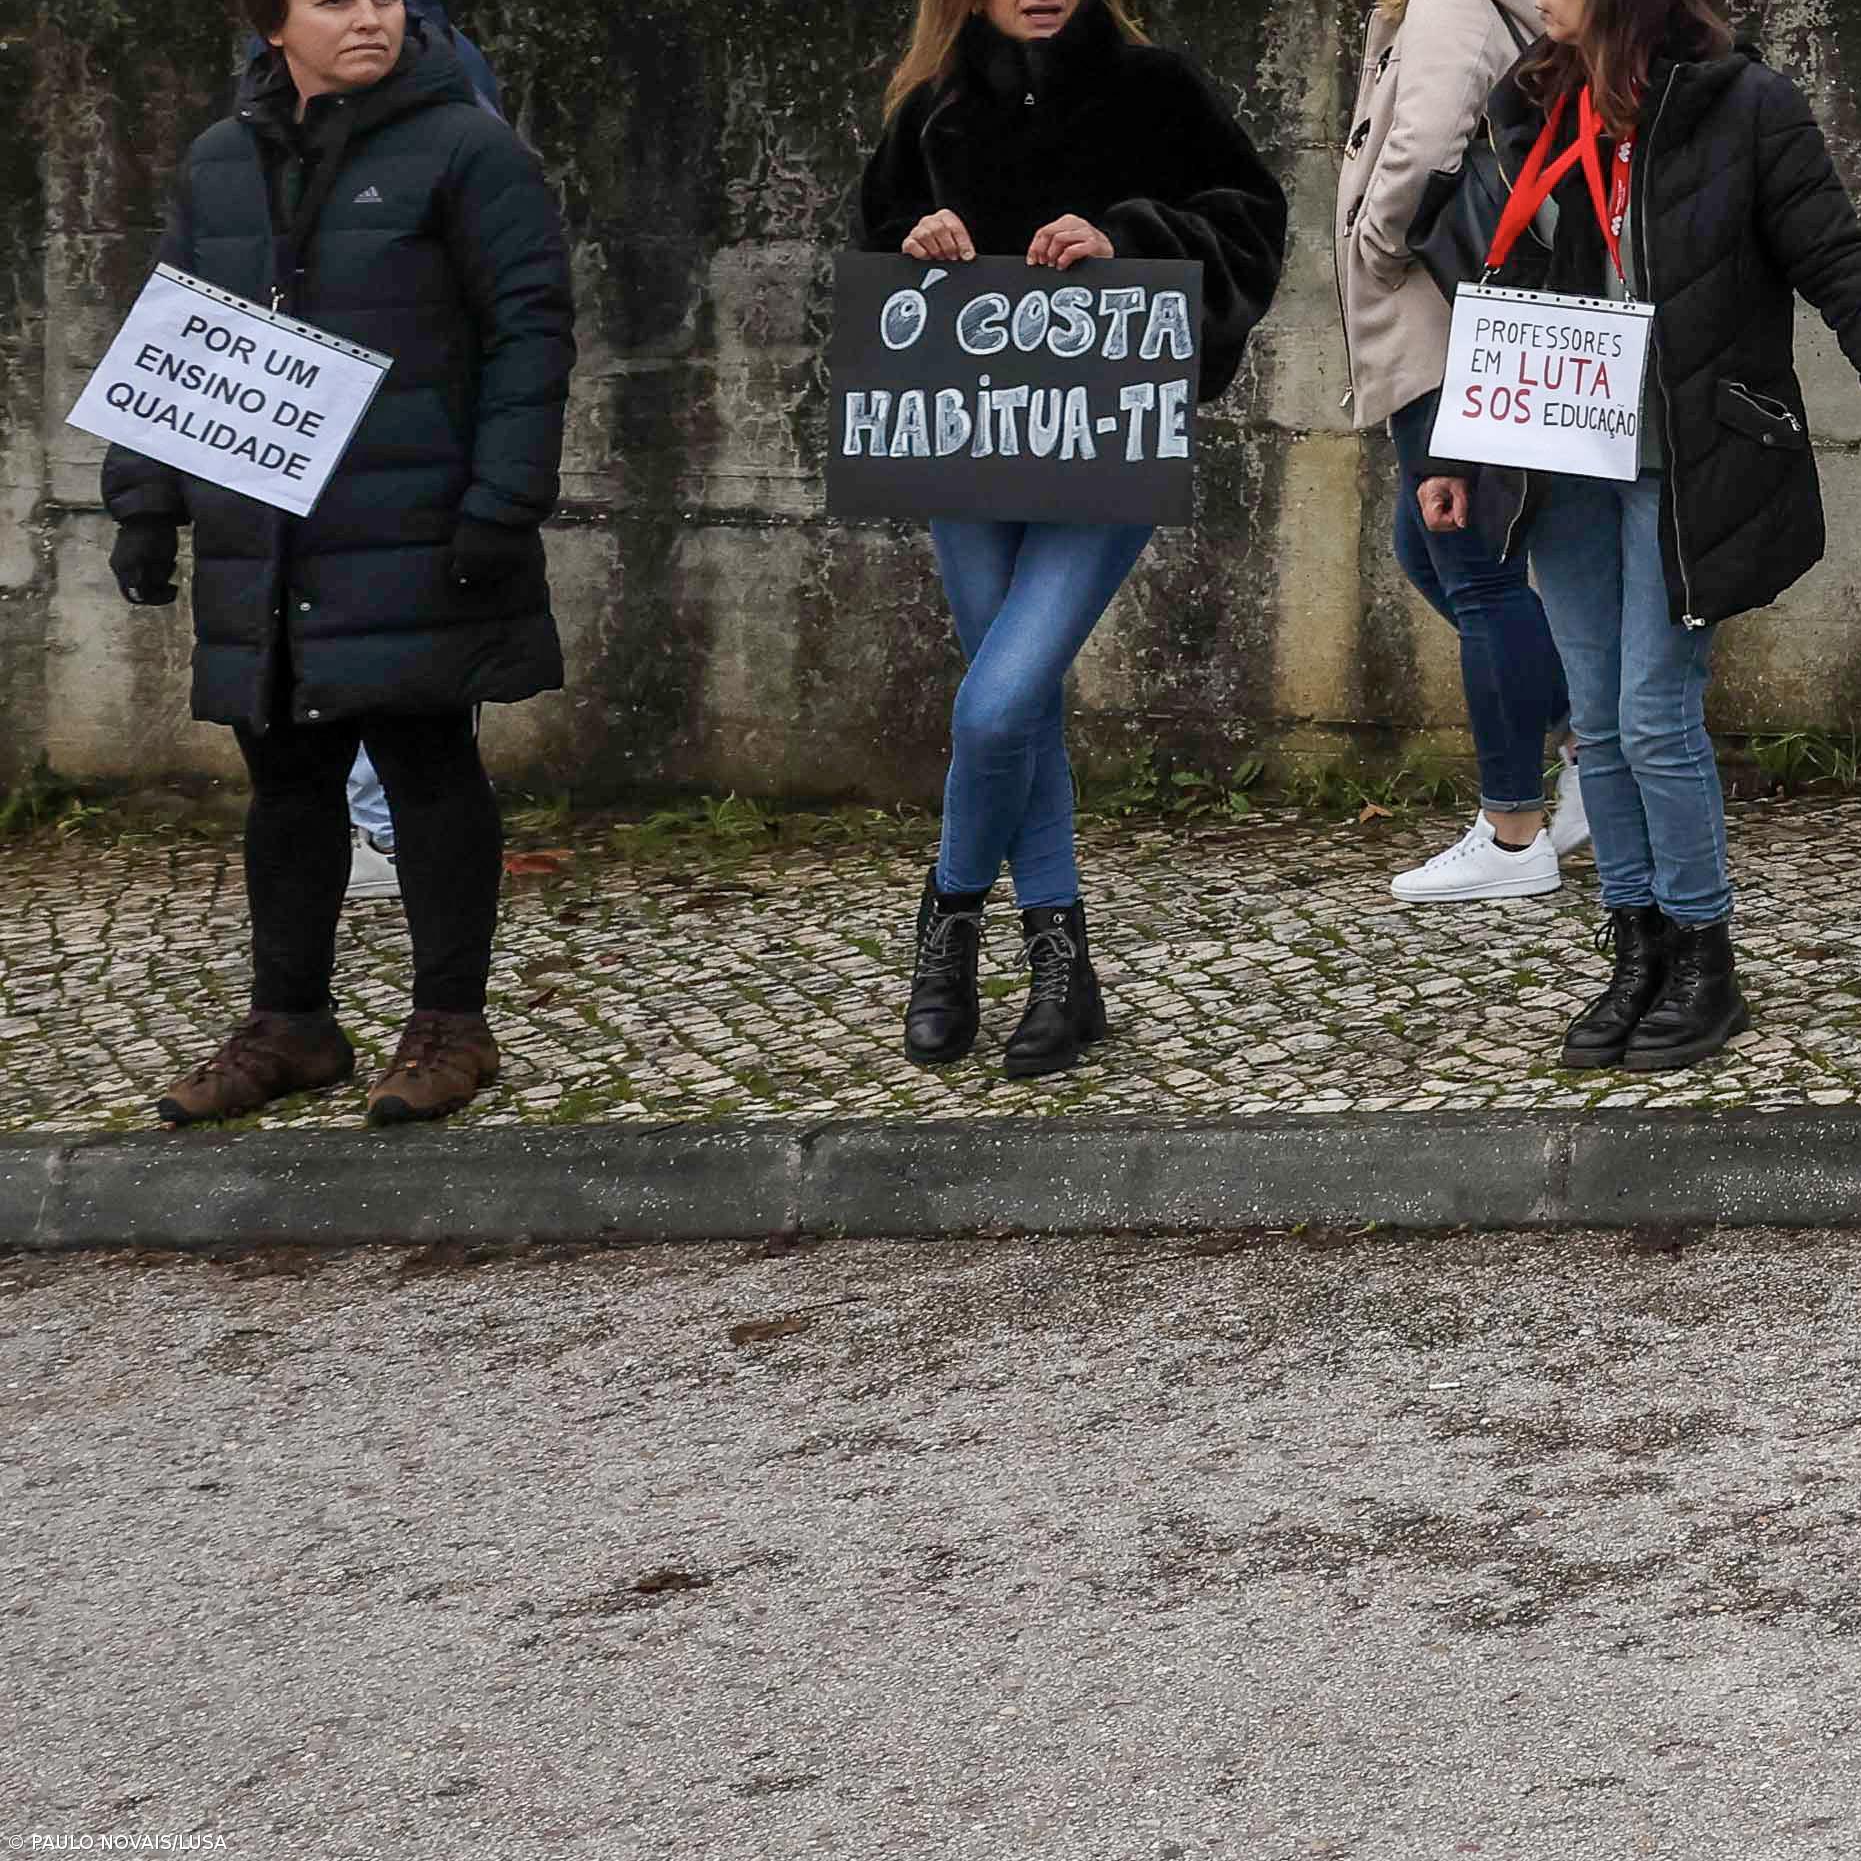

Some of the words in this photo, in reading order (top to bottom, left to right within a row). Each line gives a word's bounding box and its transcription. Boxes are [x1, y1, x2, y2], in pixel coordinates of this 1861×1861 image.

[880, 268, 949, 352] Ó
[955, 285, 1195, 361] COSTA
[1475, 317, 1623, 358] PROFESSORES
[180, 315, 257, 365] POR
[263, 348, 321, 389] UM
[1471, 348, 1502, 376] EM
[1517, 351, 1611, 400] LUTA
[134, 343, 266, 414] ENSINO
[271, 400, 326, 438] DE
[1461, 384, 1532, 424] SOS
[1543, 402, 1637, 440] EDUCAÇÃO
[105, 381, 312, 481] QUALIDADE
